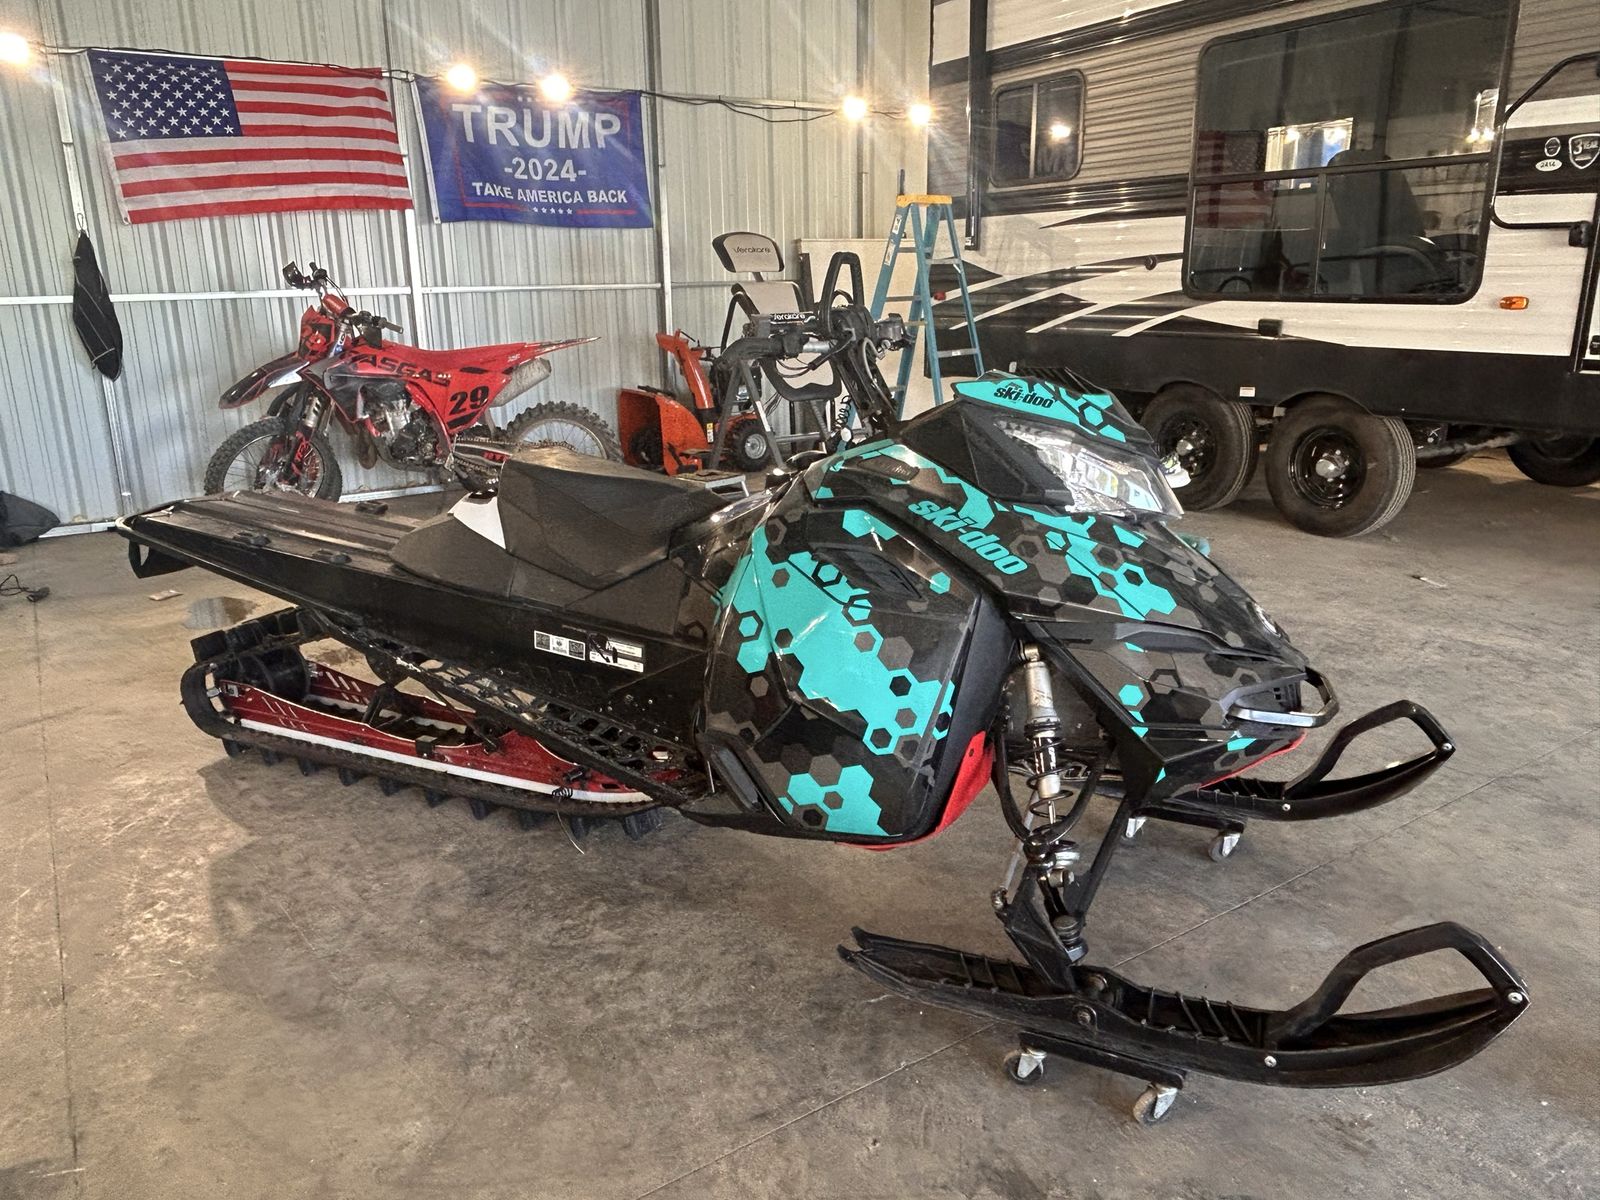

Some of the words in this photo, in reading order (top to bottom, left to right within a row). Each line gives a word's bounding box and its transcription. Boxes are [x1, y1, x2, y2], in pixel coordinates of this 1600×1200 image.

[452, 104, 621, 149] TRUMP
[472, 181, 514, 200] TAKE
[517, 188, 583, 204] AMERICA
[587, 189, 628, 204] BACK
[449, 385, 490, 415] 29
[907, 500, 1028, 575] ski-doo
